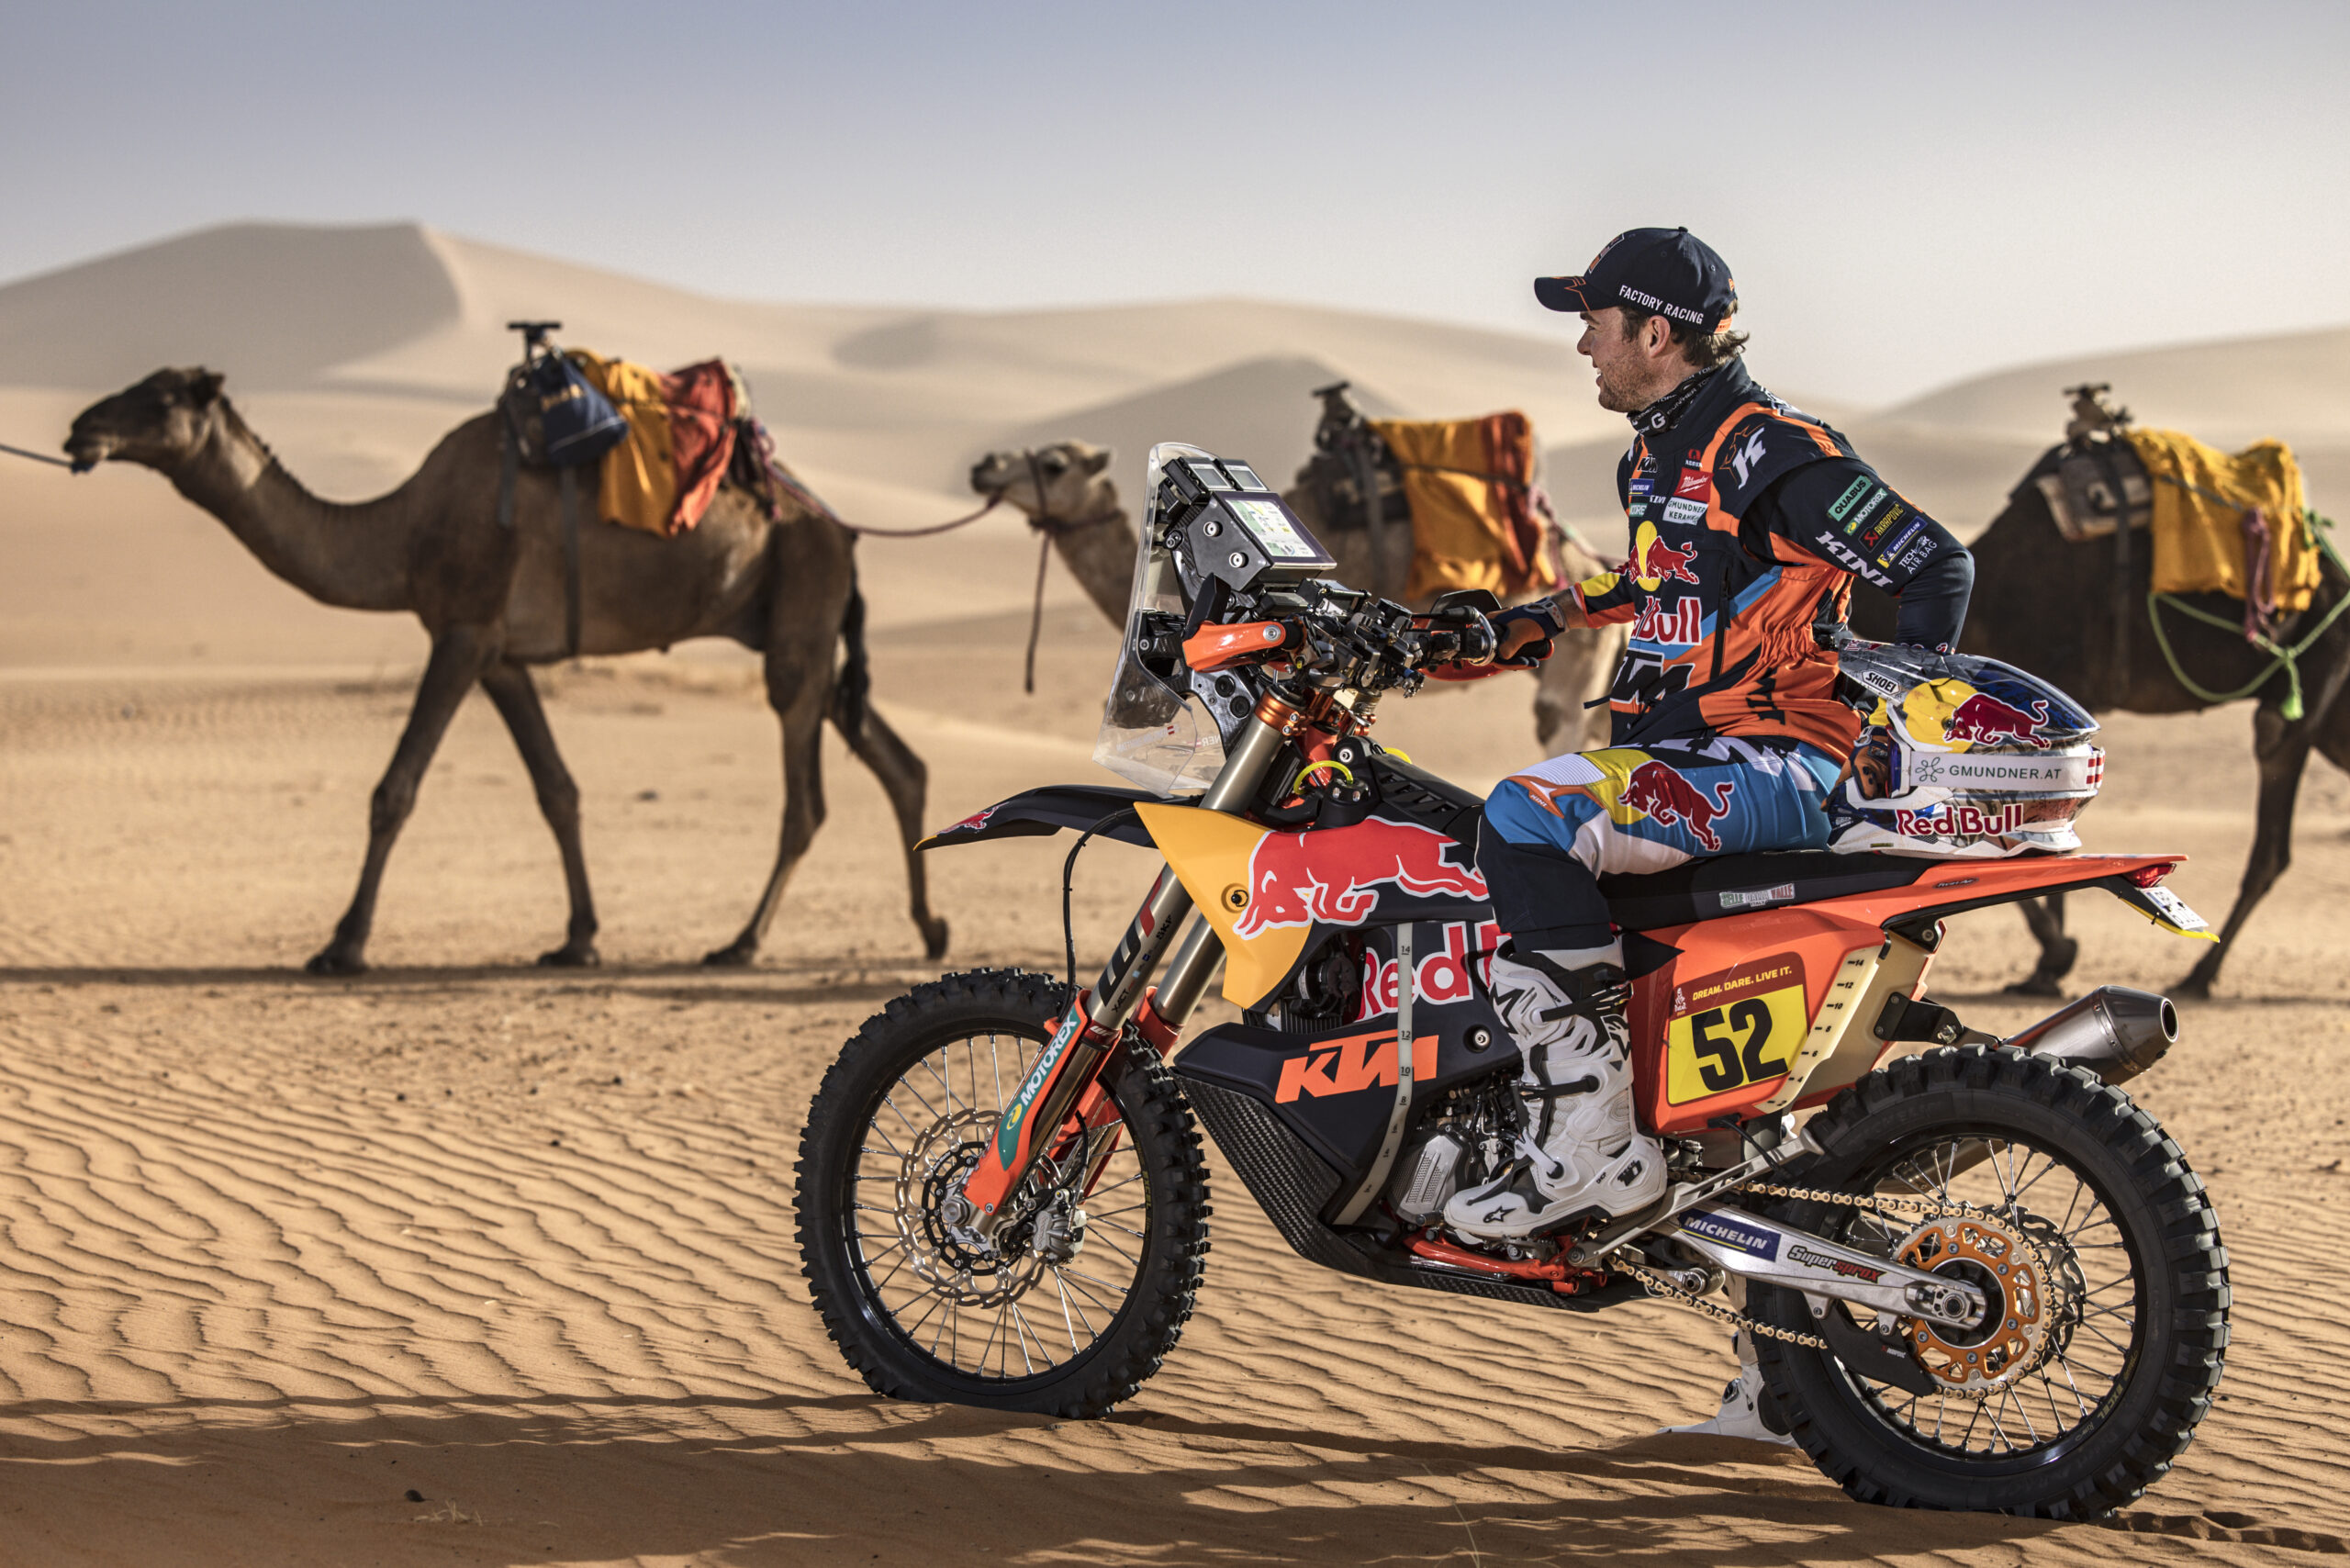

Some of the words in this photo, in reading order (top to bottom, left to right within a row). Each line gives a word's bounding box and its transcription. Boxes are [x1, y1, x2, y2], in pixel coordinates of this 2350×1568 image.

[1618, 285, 1664, 311] FACTORY
[1663, 303, 1705, 325] RACING
[1667, 500, 1706, 513] GMUNDNER
[1834, 479, 1867, 515] QUABUS
[1854, 489, 1887, 524] MOTOREX
[1893, 521, 1921, 552] MICHELIN
[1815, 531, 1894, 588] KINI
[1907, 557, 1923, 576] AIR
[1919, 541, 1938, 559] BAG
[1865, 672, 1897, 693] SHOEI
[1949, 765, 2062, 780] GMUNDNER.AT
[1896, 806, 1955, 836] Red
[1958, 803, 2024, 836] Bull
[1721, 892, 1744, 907] SELLE
[1744, 888, 1769, 902] DALLA
[1770, 881, 1794, 900] VALLE
[1356, 921, 1473, 1023] Red
[1692, 984, 1723, 1002] DREAM.
[1724, 975, 1754, 991] DARE.
[1755, 969, 1778, 983] LIVE
[1779, 966, 1793, 977] IT.
[1020, 1014, 1078, 1106] MOTOREX
[1691, 998, 1789, 1092] 52
[1275, 1028, 1439, 1104] KTM
[1796, 1075, 1804, 1083] 4
[1684, 1216, 1768, 1250] MICHELIN
[1788, 1245, 1886, 1283] Supersprox
